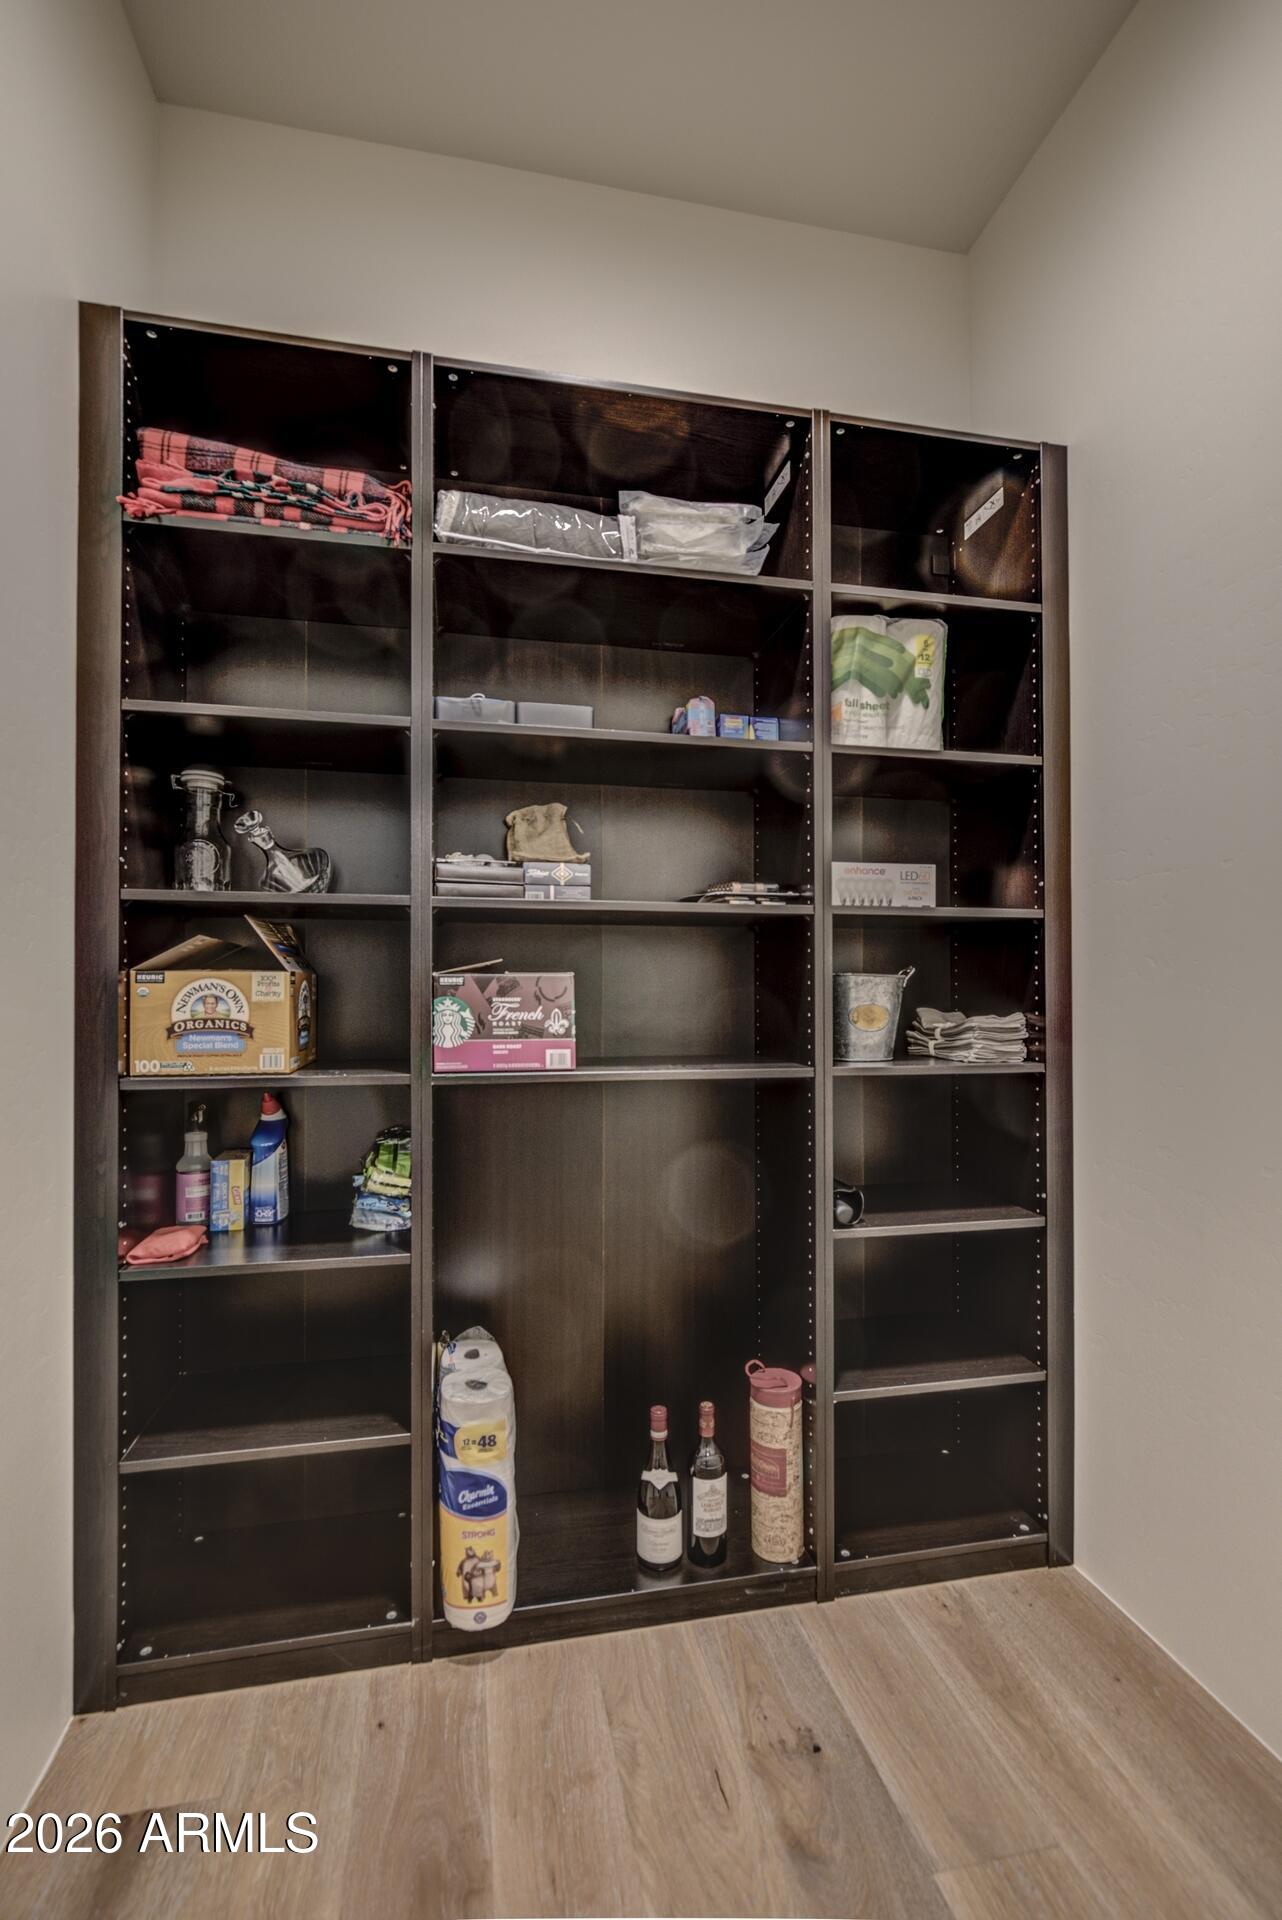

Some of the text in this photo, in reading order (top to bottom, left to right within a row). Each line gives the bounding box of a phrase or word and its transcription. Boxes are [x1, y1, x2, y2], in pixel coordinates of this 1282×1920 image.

[844, 697, 890, 711] full sheet
[843, 866, 886, 876] enhance
[176, 982, 246, 1014] NEWMAN'S OWN
[488, 1003, 543, 1020] French
[174, 1020, 248, 1032] ORGANICS
[182, 1041, 239, 1050] Special Blend
[134, 1060, 159, 1073] 100
[462, 1438, 471, 1446] 12
[477, 1434, 497, 1448] 48
[458, 1484, 495, 1504] Charmin
[462, 1529, 495, 1539] STRONG
